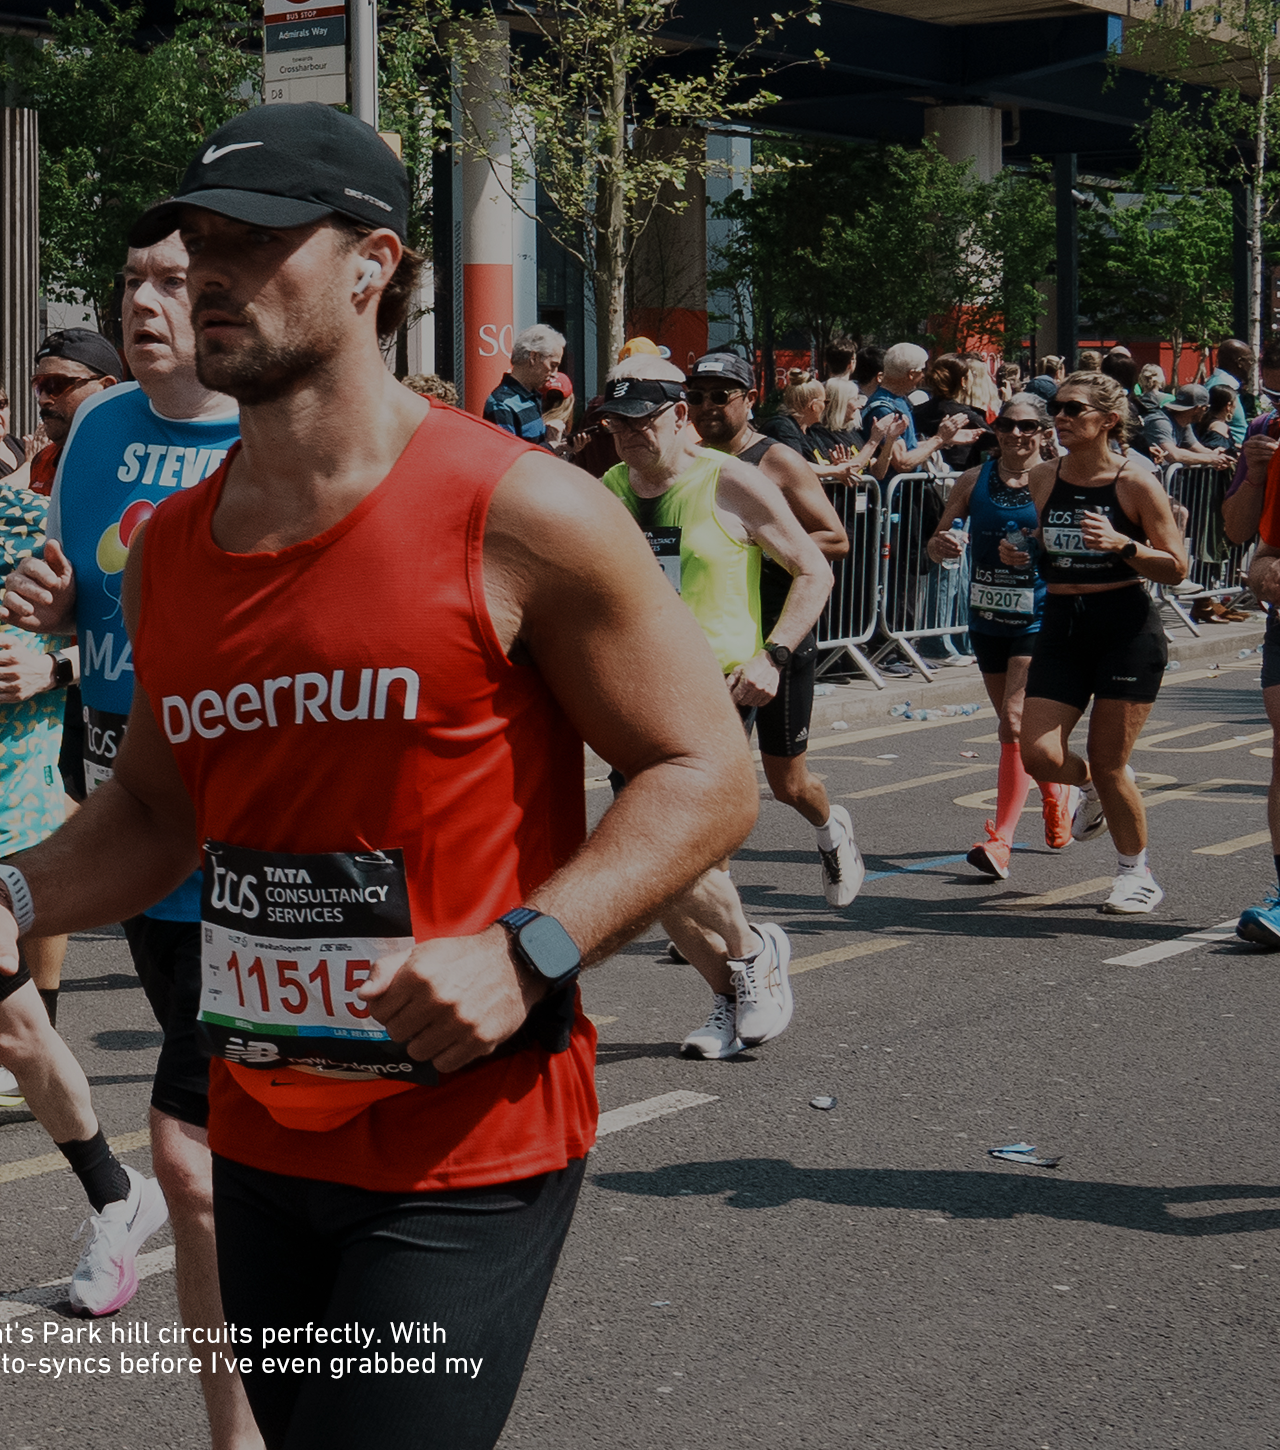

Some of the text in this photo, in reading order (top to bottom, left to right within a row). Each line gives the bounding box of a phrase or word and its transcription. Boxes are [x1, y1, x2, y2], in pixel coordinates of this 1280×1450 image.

[286, 10, 317, 20] BUS STOP
[278, 26, 329, 40] Admirals Way
[279, 62, 328, 74] Crossharbour
[271, 89, 283, 100] D8
[978, 589, 1022, 608] 79207
[88, 722, 117, 759] tcs
[263, 866, 312, 884] TATA
[211, 856, 259, 919] tcs
[265, 885, 389, 904] CONSULTANCY
[267, 907, 344, 923] SERVICES
[227, 951, 371, 1019] 11515
